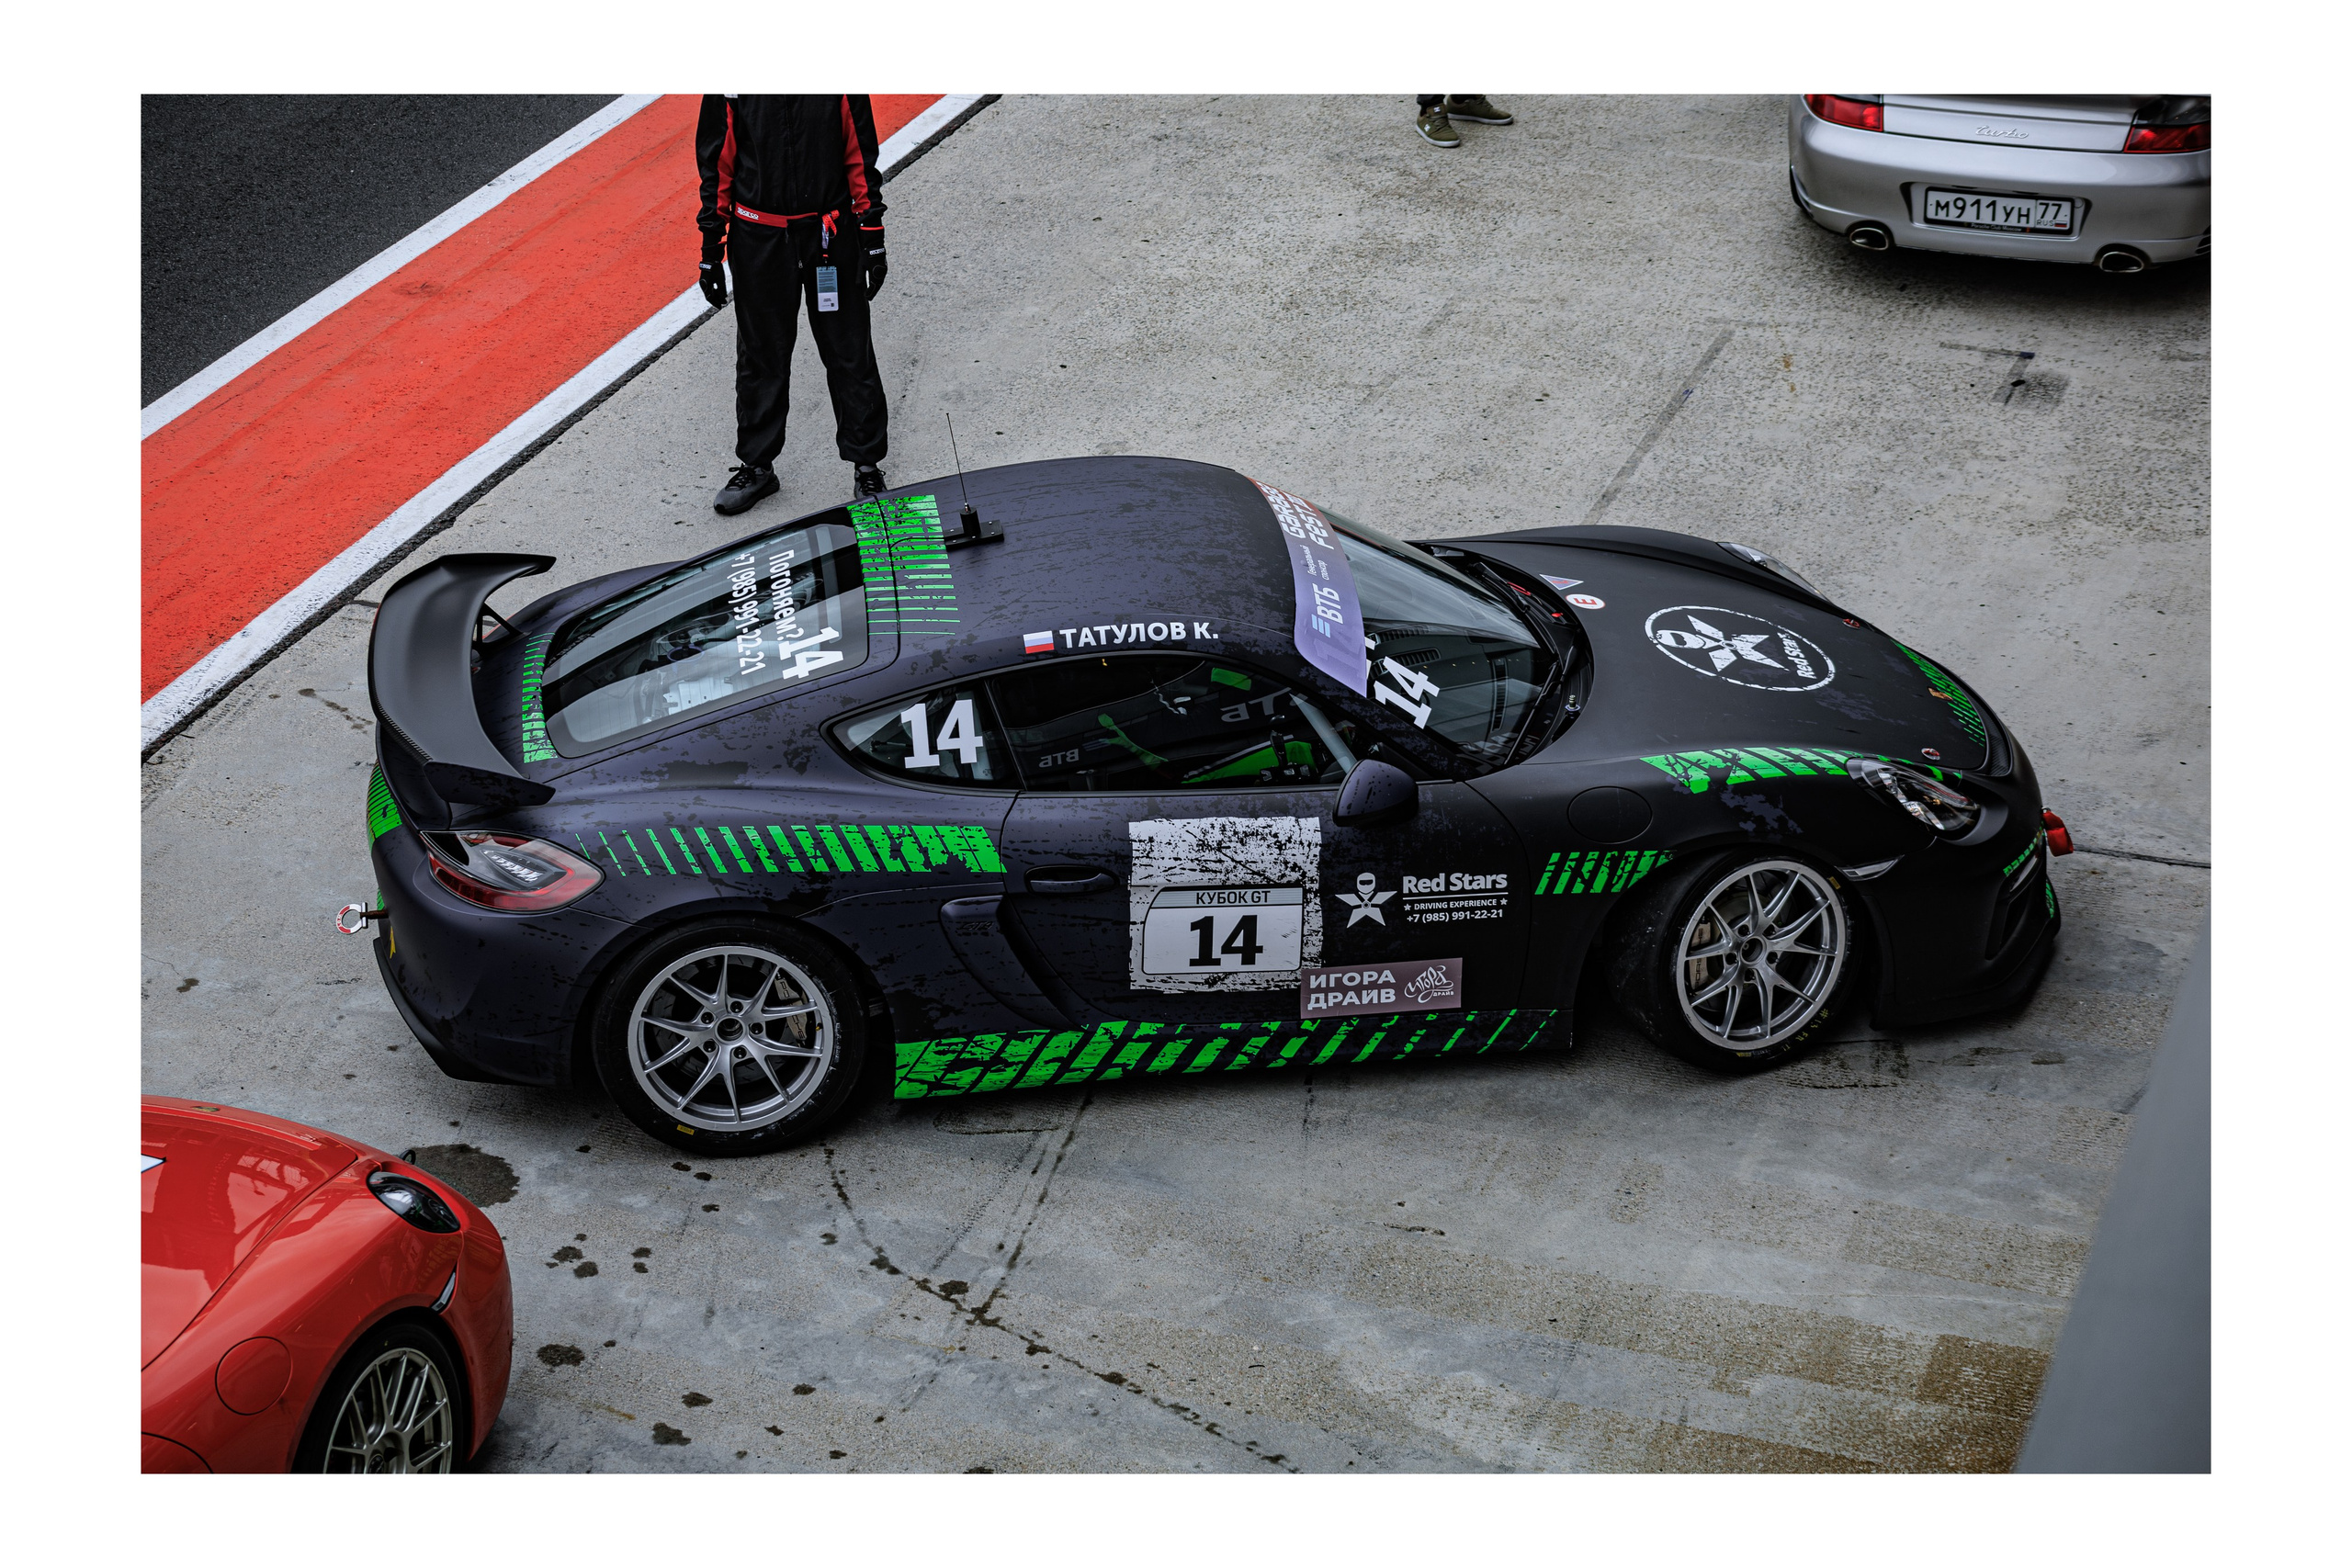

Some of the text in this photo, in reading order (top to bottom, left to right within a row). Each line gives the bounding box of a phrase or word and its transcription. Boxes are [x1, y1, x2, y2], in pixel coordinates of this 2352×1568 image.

[1975, 125, 2029, 139] turbo
[2039, 202, 2063, 220] 77
[2036, 219, 2054, 227] RUS
[1312, 582, 1344, 625] ВТБ
[1573, 597, 1598, 606] E
[727, 553, 766, 675] +7 (985) 991-22-21
[1059, 622, 1220, 649] ТАТУЛОВ К.
[778, 626, 844, 680] 14
[1788, 656, 1817, 680] Red
[1373, 655, 1441, 730] 14
[899, 698, 984, 770] 14
[1402, 872, 1510, 895] Red Stars
[1195, 889, 1272, 906] КУБОК GT
[1413, 898, 1498, 910] DRIVING EXPERIENCE
[1406, 908, 1504, 924] +7 (985) 991-22-21
[1189, 914, 1264, 968] 14
[1309, 970, 1396, 989] ИГОРА
[1306, 988, 1396, 1010] ДРАЙВ
